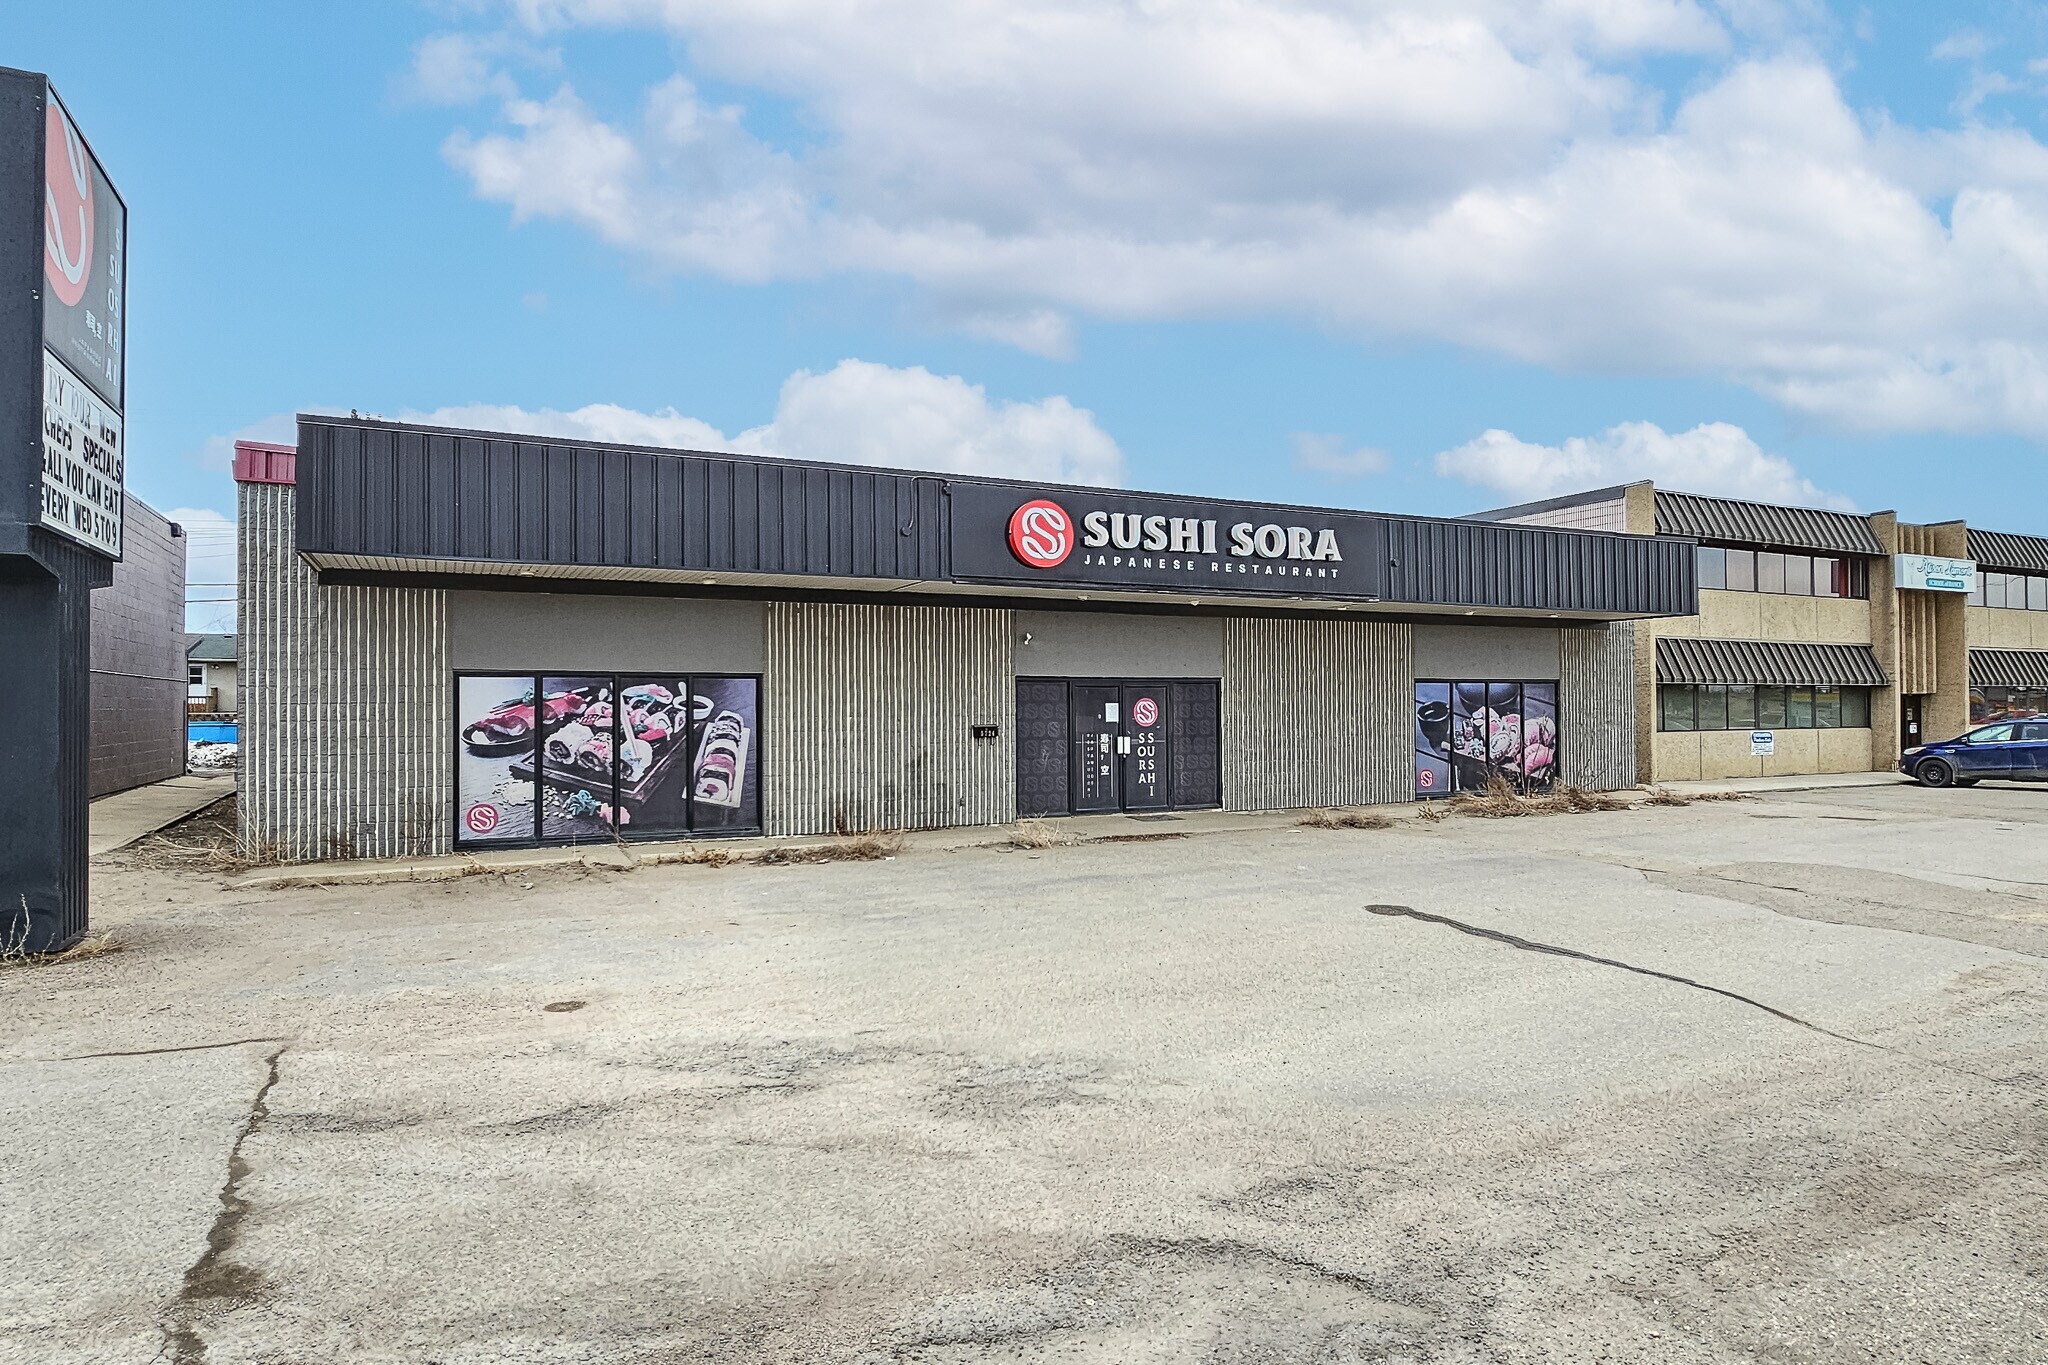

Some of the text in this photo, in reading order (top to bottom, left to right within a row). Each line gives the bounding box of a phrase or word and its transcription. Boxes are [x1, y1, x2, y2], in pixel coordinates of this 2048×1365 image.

[47, 446, 63, 484] ALL
[65, 457, 84, 496] YOU
[86, 472, 102, 507] CAN
[104, 483, 118, 516] EAT
[83, 435, 121, 484] SPECIALS
[73, 500, 92, 534] WED
[112, 521, 117, 547] 9
[1083, 511, 1343, 562] SUSHI SORA
[1084, 554, 1339, 579] JAPANESE RESTAURANT
[1137, 733, 1147, 784] SORA
[1147, 732, 1156, 797] SUSHI
